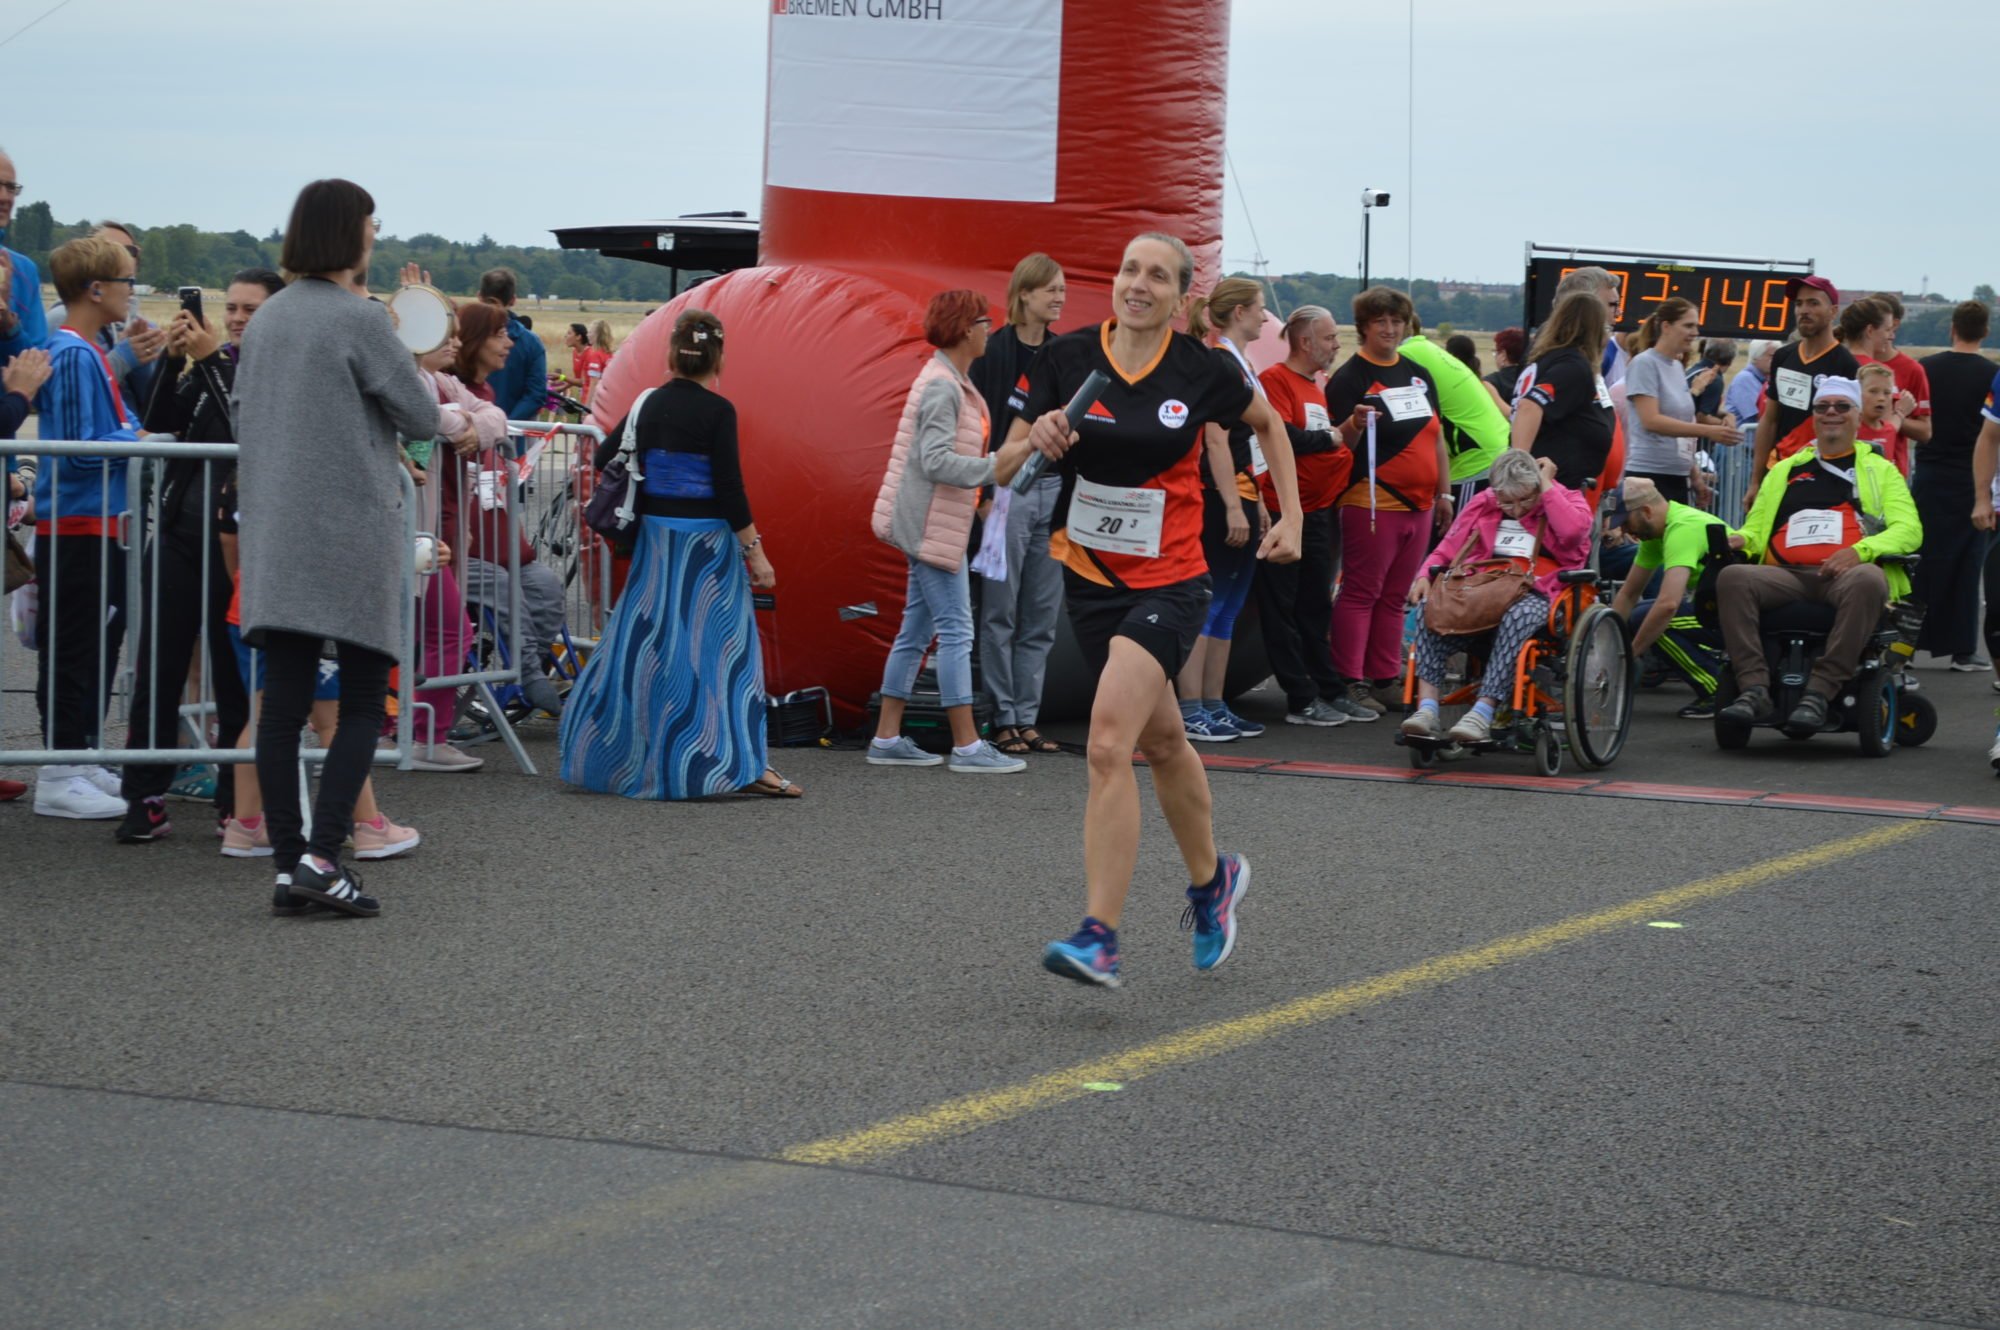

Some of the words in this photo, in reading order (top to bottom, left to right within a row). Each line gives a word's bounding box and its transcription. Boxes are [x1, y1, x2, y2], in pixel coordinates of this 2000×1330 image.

[788, 0, 856, 17] BREMEN
[867, 0, 943, 20] GMBH
[1096, 516, 1123, 535] 20
[1807, 524, 1819, 535] 17
